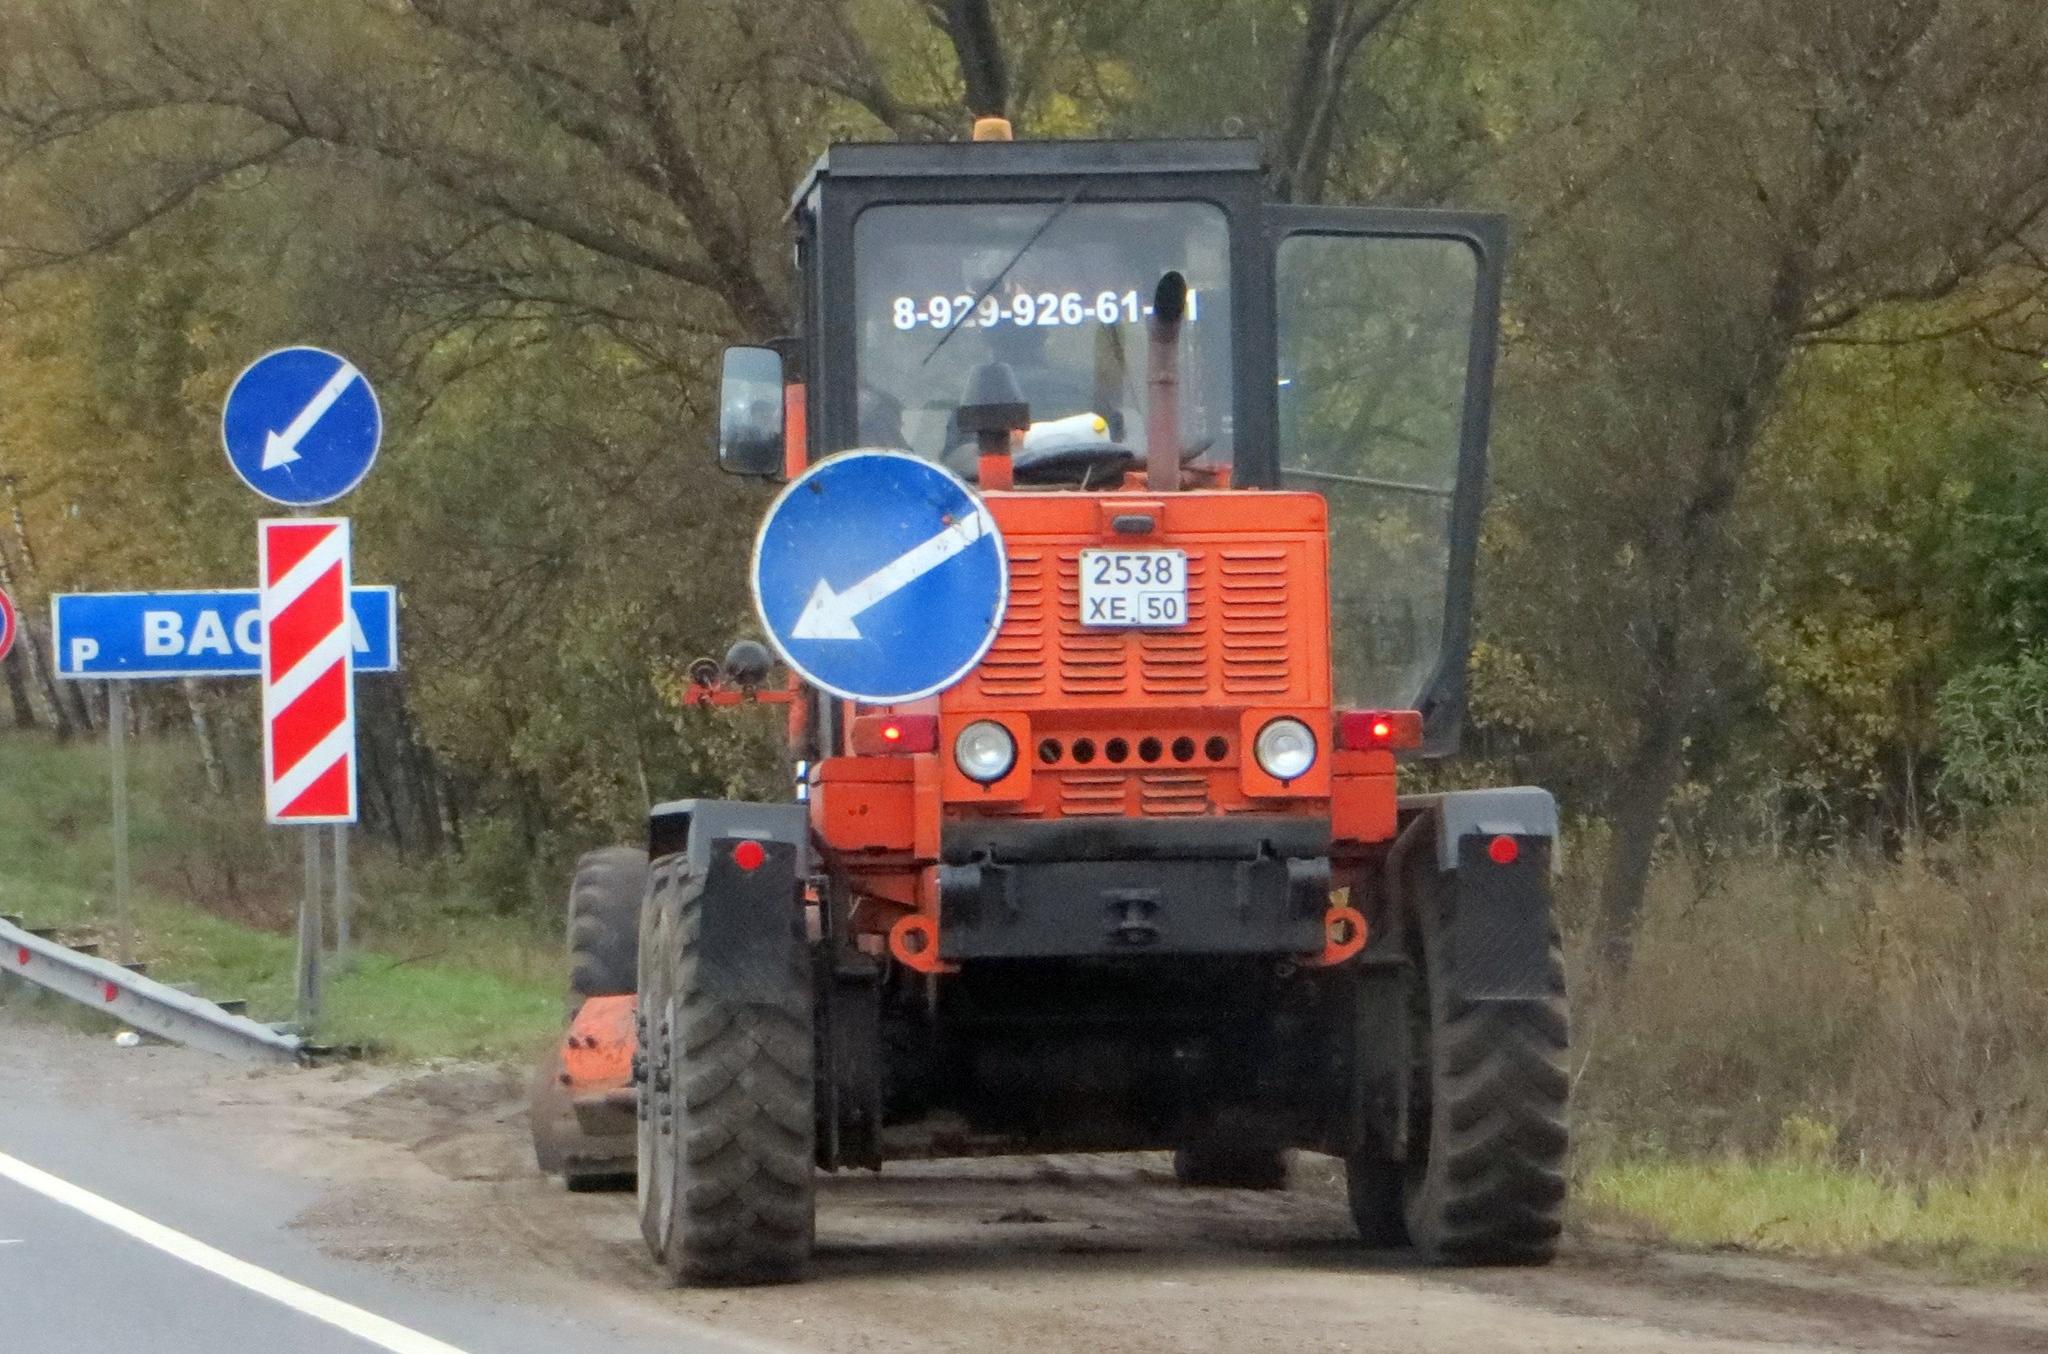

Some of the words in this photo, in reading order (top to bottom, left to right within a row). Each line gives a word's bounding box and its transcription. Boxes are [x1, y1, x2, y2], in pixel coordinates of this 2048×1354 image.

[893, 288, 1198, 330] 8-929-926-61-1
[1094, 555, 1173, 585] 2538
[1089, 597, 1127, 620] ХЕ
[1148, 597, 1178, 620] 50
[144, 607, 371, 656] ВАС
